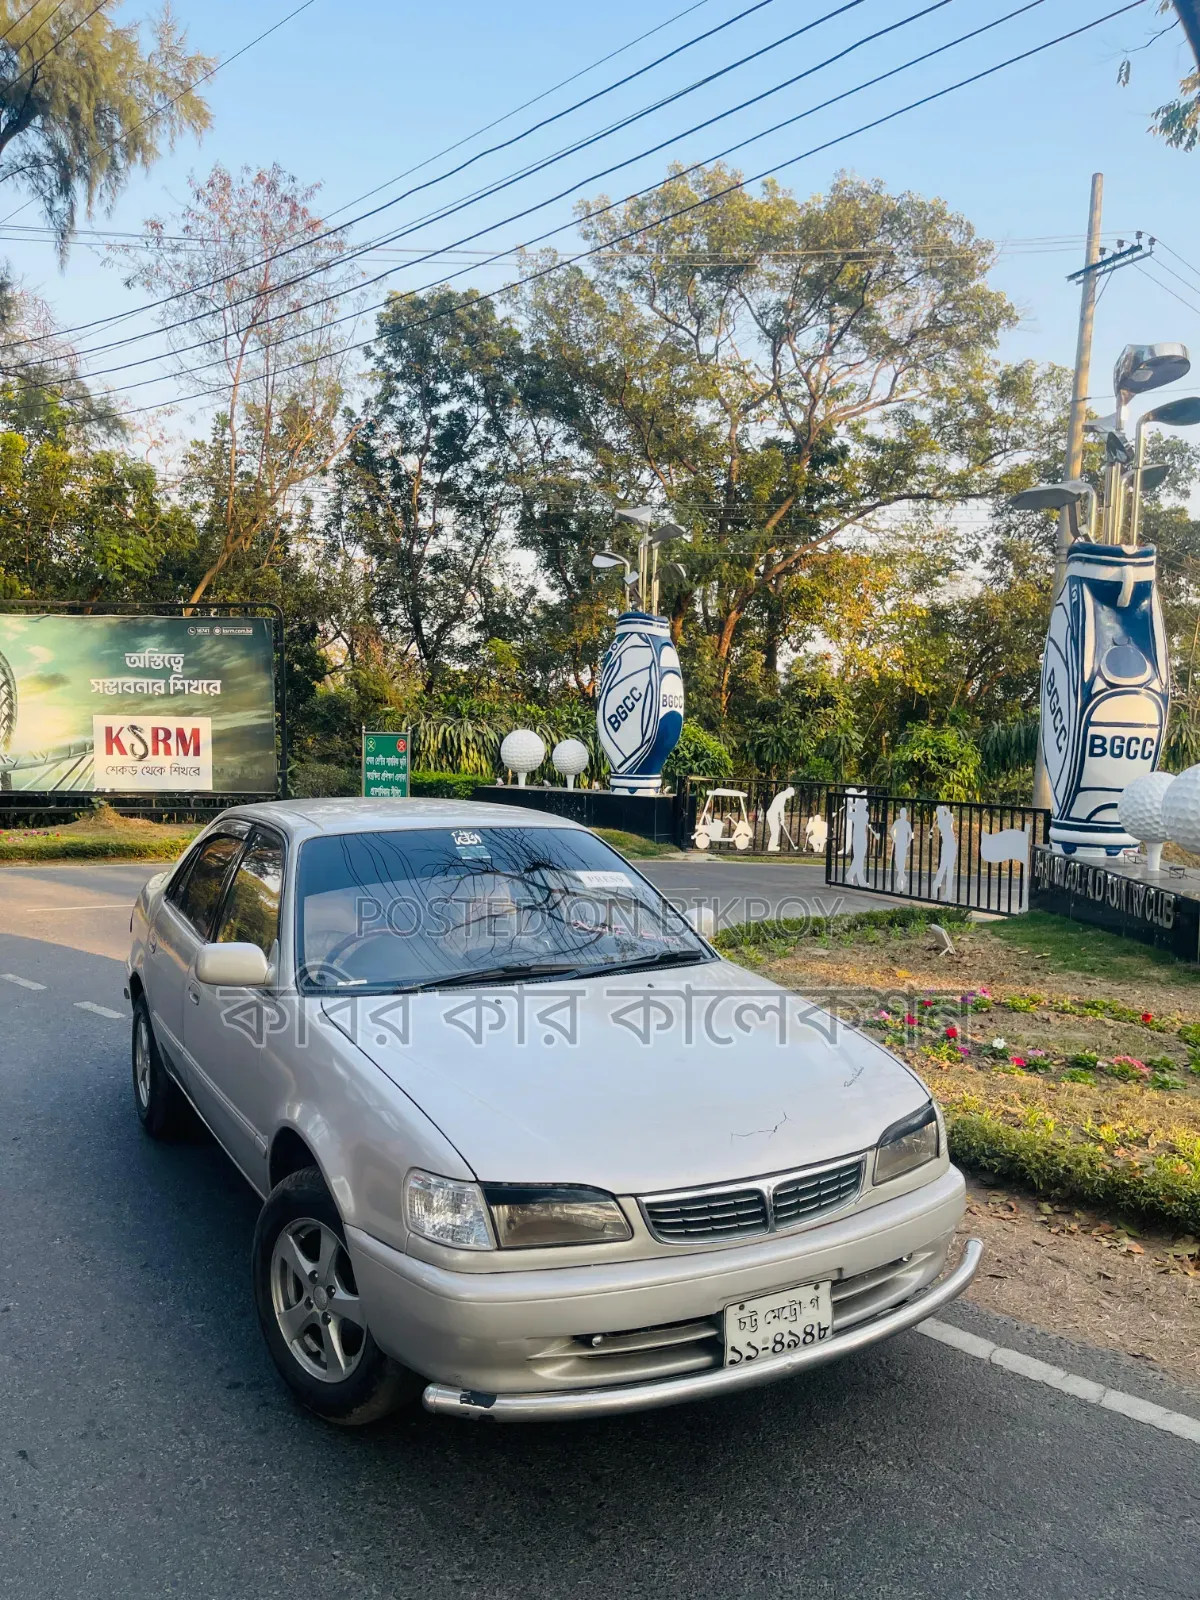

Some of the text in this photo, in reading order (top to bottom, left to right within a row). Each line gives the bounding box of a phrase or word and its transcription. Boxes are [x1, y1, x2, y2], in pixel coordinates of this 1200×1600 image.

[90, 674, 221, 696] সম্ভাবনার শিখরে
[662, 693, 683, 709] BGCC
[607, 686, 643, 733] BGCC
[1047, 667, 1068, 754] BGCC
[105, 724, 201, 761] KSRM
[1089, 733, 1154, 761] BGCC
[1145, 887, 1176, 929] CLUB
[728, 1321, 830, 1366] ১১-৪৯৪৮
